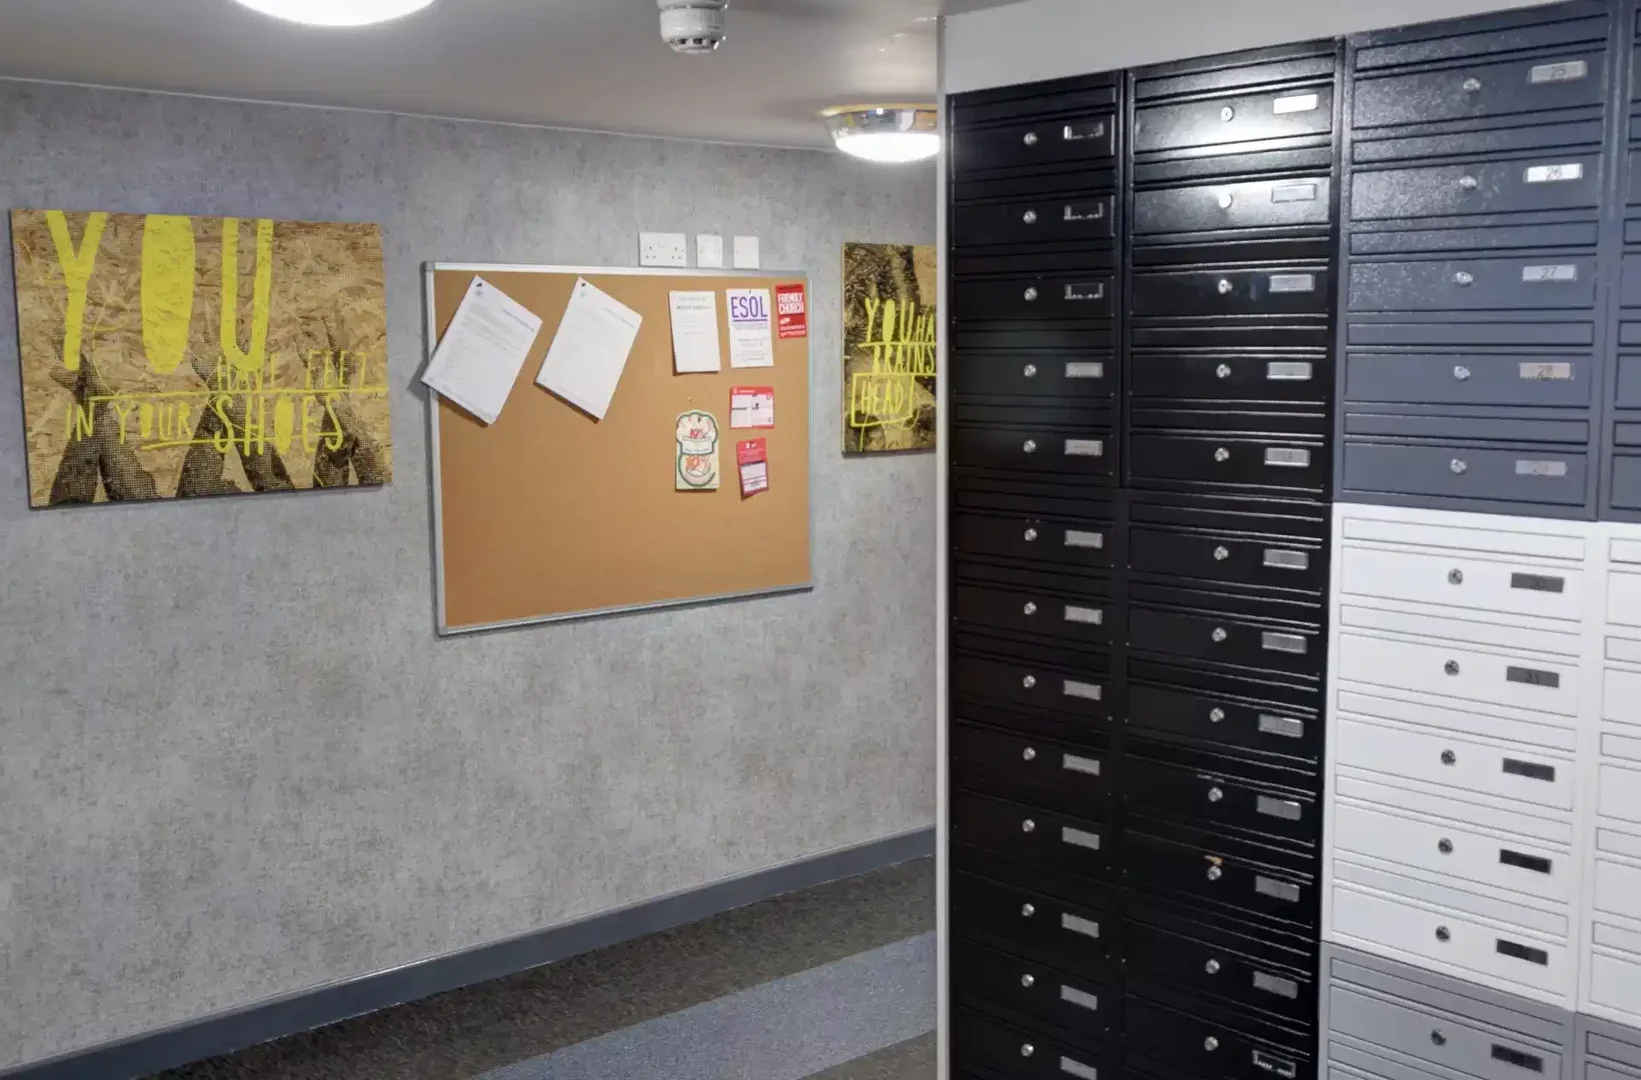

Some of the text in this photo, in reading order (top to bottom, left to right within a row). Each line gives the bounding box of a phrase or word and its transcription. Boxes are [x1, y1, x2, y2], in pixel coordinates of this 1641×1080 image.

[46, 210, 274, 375] YOU
[731, 296, 768, 318] ESOL
[779, 301, 804, 315] CHURCH
[865, 297, 936, 347] YOU HA
[305, 349, 368, 390] FEET
[861, 379, 904, 415] HEAD
[65, 393, 344, 457] IN YOUR SHOES
